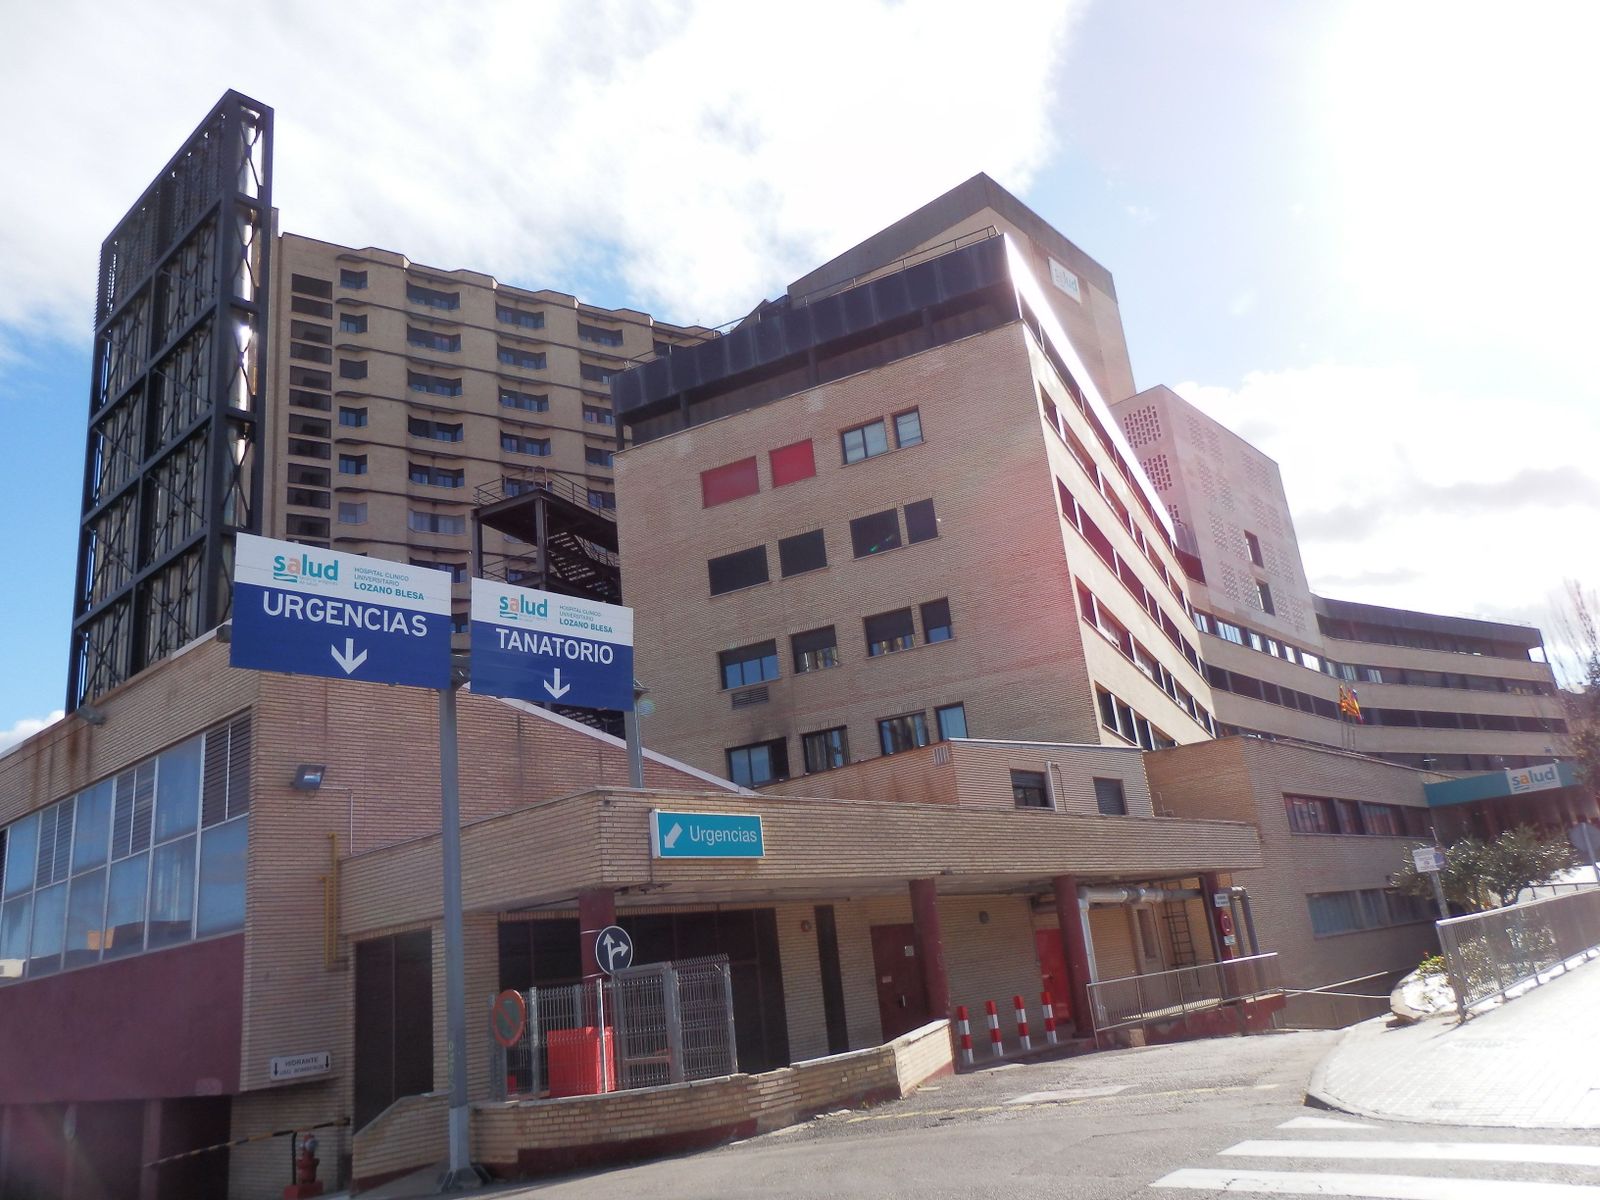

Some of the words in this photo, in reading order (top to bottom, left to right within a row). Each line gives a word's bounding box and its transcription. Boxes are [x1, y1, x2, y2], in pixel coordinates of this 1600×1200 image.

[273, 554, 338, 581] salud
[354, 567, 383, 577] HOSPITAL
[354, 574, 400, 587] UNIVERSITARIO
[354, 581, 393, 595] LOZANO
[395, 589, 424, 600] BLESA
[263, 590, 428, 638] URGENCIAS
[499, 594, 548, 618] salud
[559, 617, 589, 629] LOZANO
[590, 623, 613, 633] BLESA
[495, 627, 614, 665] TANATORIO
[1511, 767, 1555, 786] salud
[689, 825, 758, 846] Urgencias
